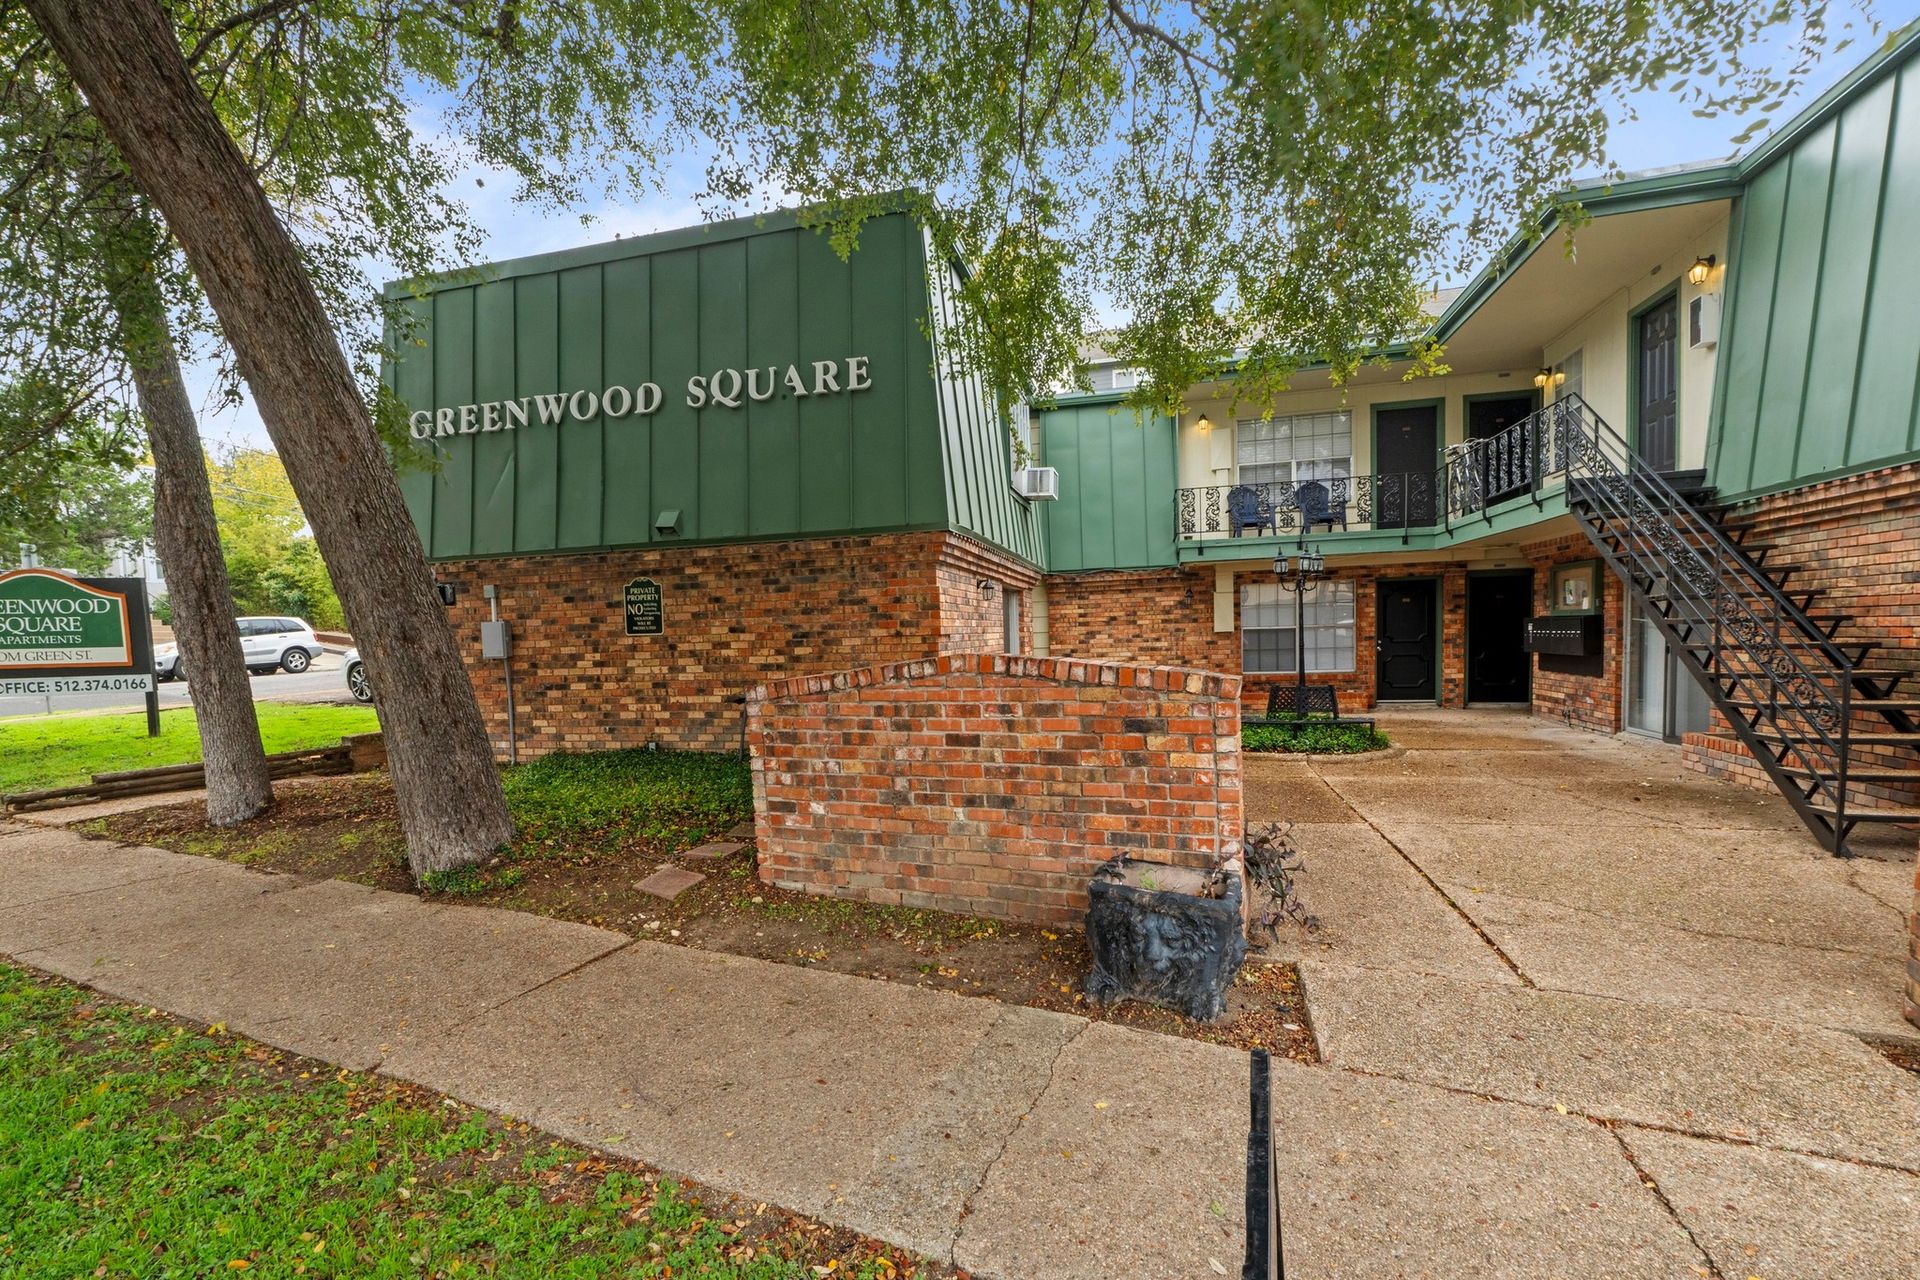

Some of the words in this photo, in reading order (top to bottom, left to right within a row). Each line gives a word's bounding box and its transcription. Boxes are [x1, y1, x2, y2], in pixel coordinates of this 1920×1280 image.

[409, 382, 663, 439] GREENWOOD
[687, 356, 872, 408] SQUARE
[627, 603, 643, 615] NO
[24, 650, 72, 661] GREEN
[75, 650, 93, 660] ST.
[55, 678, 147, 692] 512.374.0166
